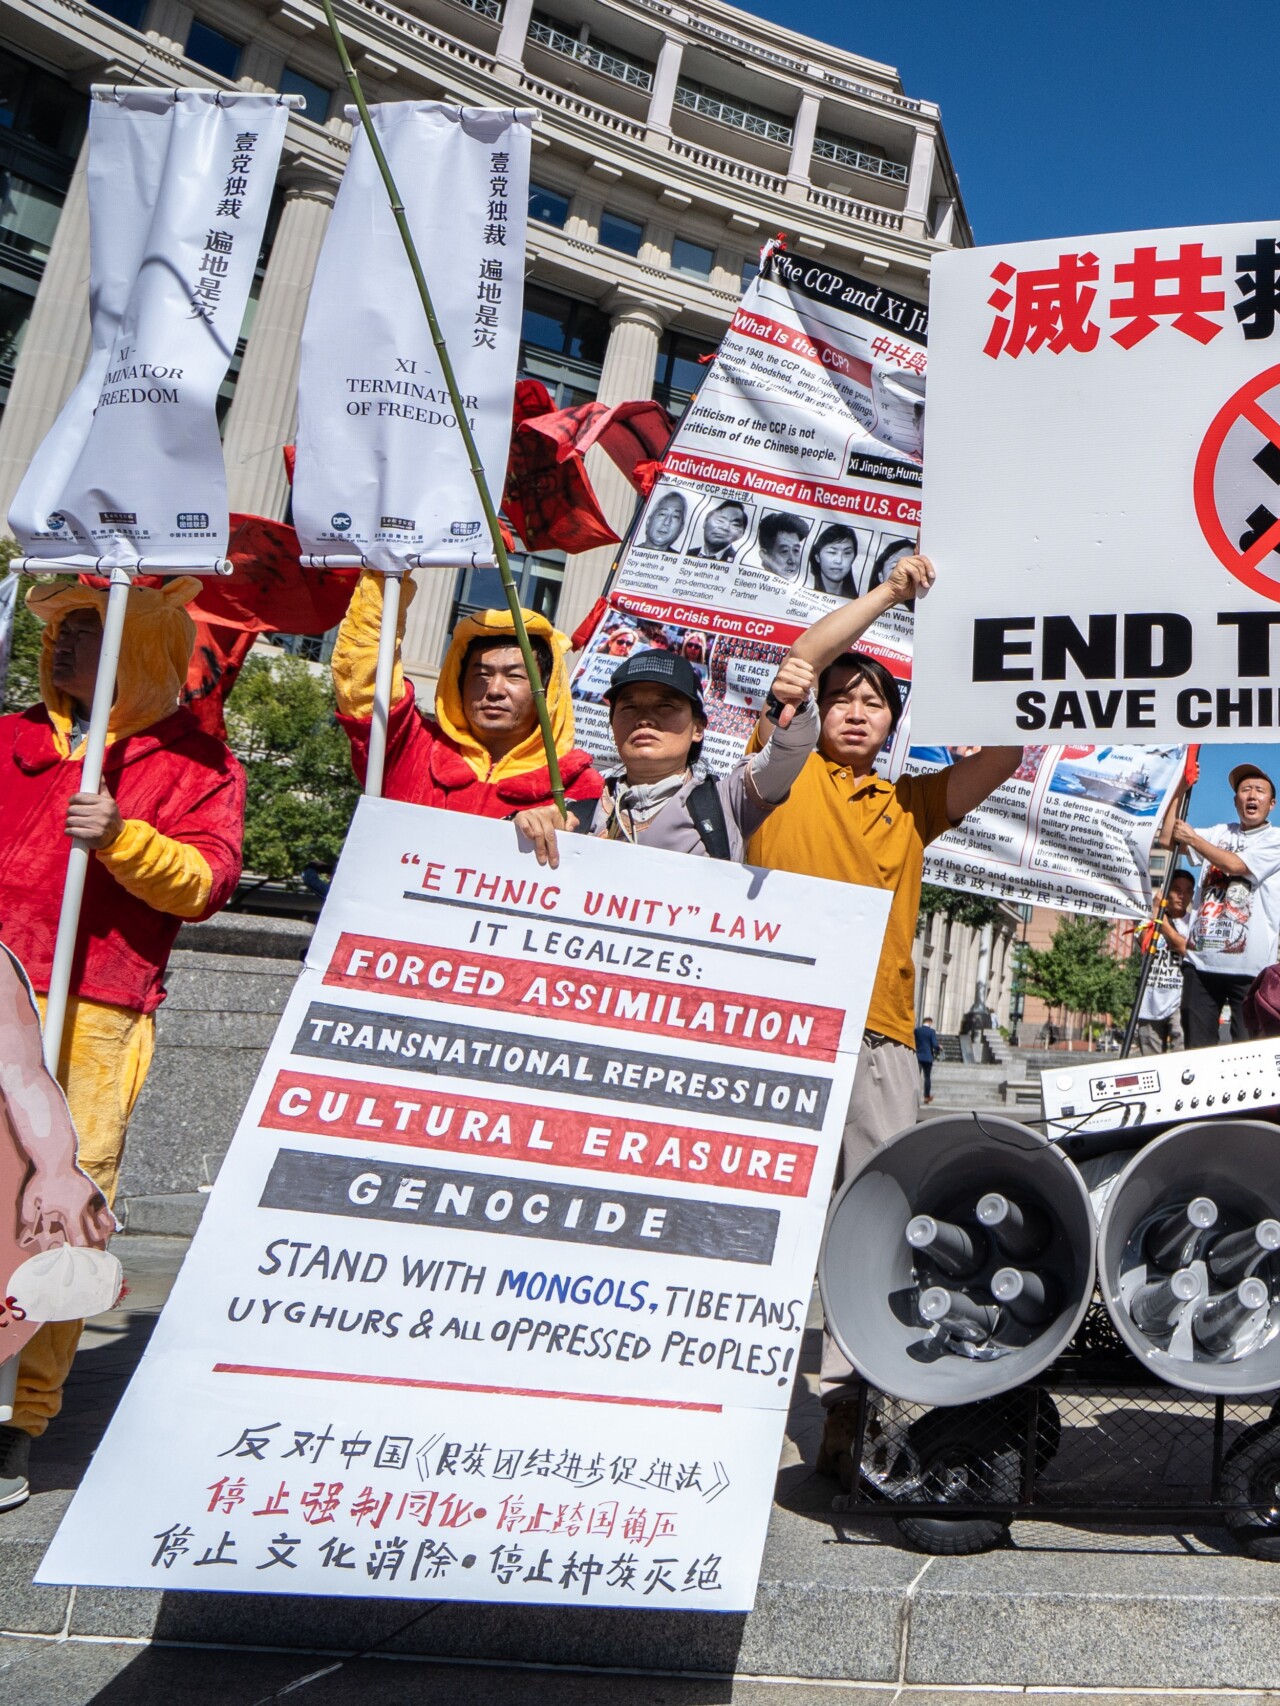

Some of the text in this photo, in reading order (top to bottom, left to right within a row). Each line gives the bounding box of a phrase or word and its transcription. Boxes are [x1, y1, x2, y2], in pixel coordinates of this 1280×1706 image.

[186, 132, 258, 325] 壹党独裁 遍地是灾
[472, 152, 510, 350] 壹党独裁 遍地是灾
[771, 254, 803, 283] The
[803, 268, 842, 296] CCP
[841, 287, 882, 313] and
[881, 292, 907, 324] Xi
[395, 358, 417, 375] XI
[734, 312, 851, 373] What Is the CCP?
[346, 401, 372, 416] OF
[738, 416, 750, 428] of
[752, 420, 768, 433] the
[769, 421, 786, 435] CCP
[788, 425, 796, 437] is
[799, 428, 815, 440] not
[729, 431, 740, 442] of
[744, 434, 761, 448] the
[763, 438, 799, 455] Chinese
[800, 447, 836, 462] people.
[664, 455, 892, 516] Individuals Named in Recent U.S.
[617, 595, 775, 637] Fentanyl Crisis from CCP
[734, 663, 770, 677] THE FACES
[851, 640, 912, 663] Surveillance
[972, 611, 1193, 684] END
[737, 674, 761, 686] BEHIND
[1014, 686, 1157, 731] SAVE
[934, 856, 943, 867] of
[946, 858, 961, 870] the
[963, 864, 986, 876] CCP
[987, 870, 1007, 881] and
[1008, 875, 1053, 891] establish
[1065, 884, 1122, 906] Democratic
[470, 920, 703, 981] IT LEGALIZES:
[709, 911, 781, 943] LAW
[345, 949, 815, 1047] FORCED ASSIMILATION
[310, 1018, 819, 1115] TRANSNATIONAL REPRESSION
[278, 1086, 797, 1183] CULTURAL ERASURE
[347, 1174, 667, 1240] GENOCIDE
[257, 1237, 803, 1335] STAND WITH MONGOLS, TIBETANS,
[227, 1296, 796, 1387] UYGHURS & ALL OPPRESSED PEOPLES!
